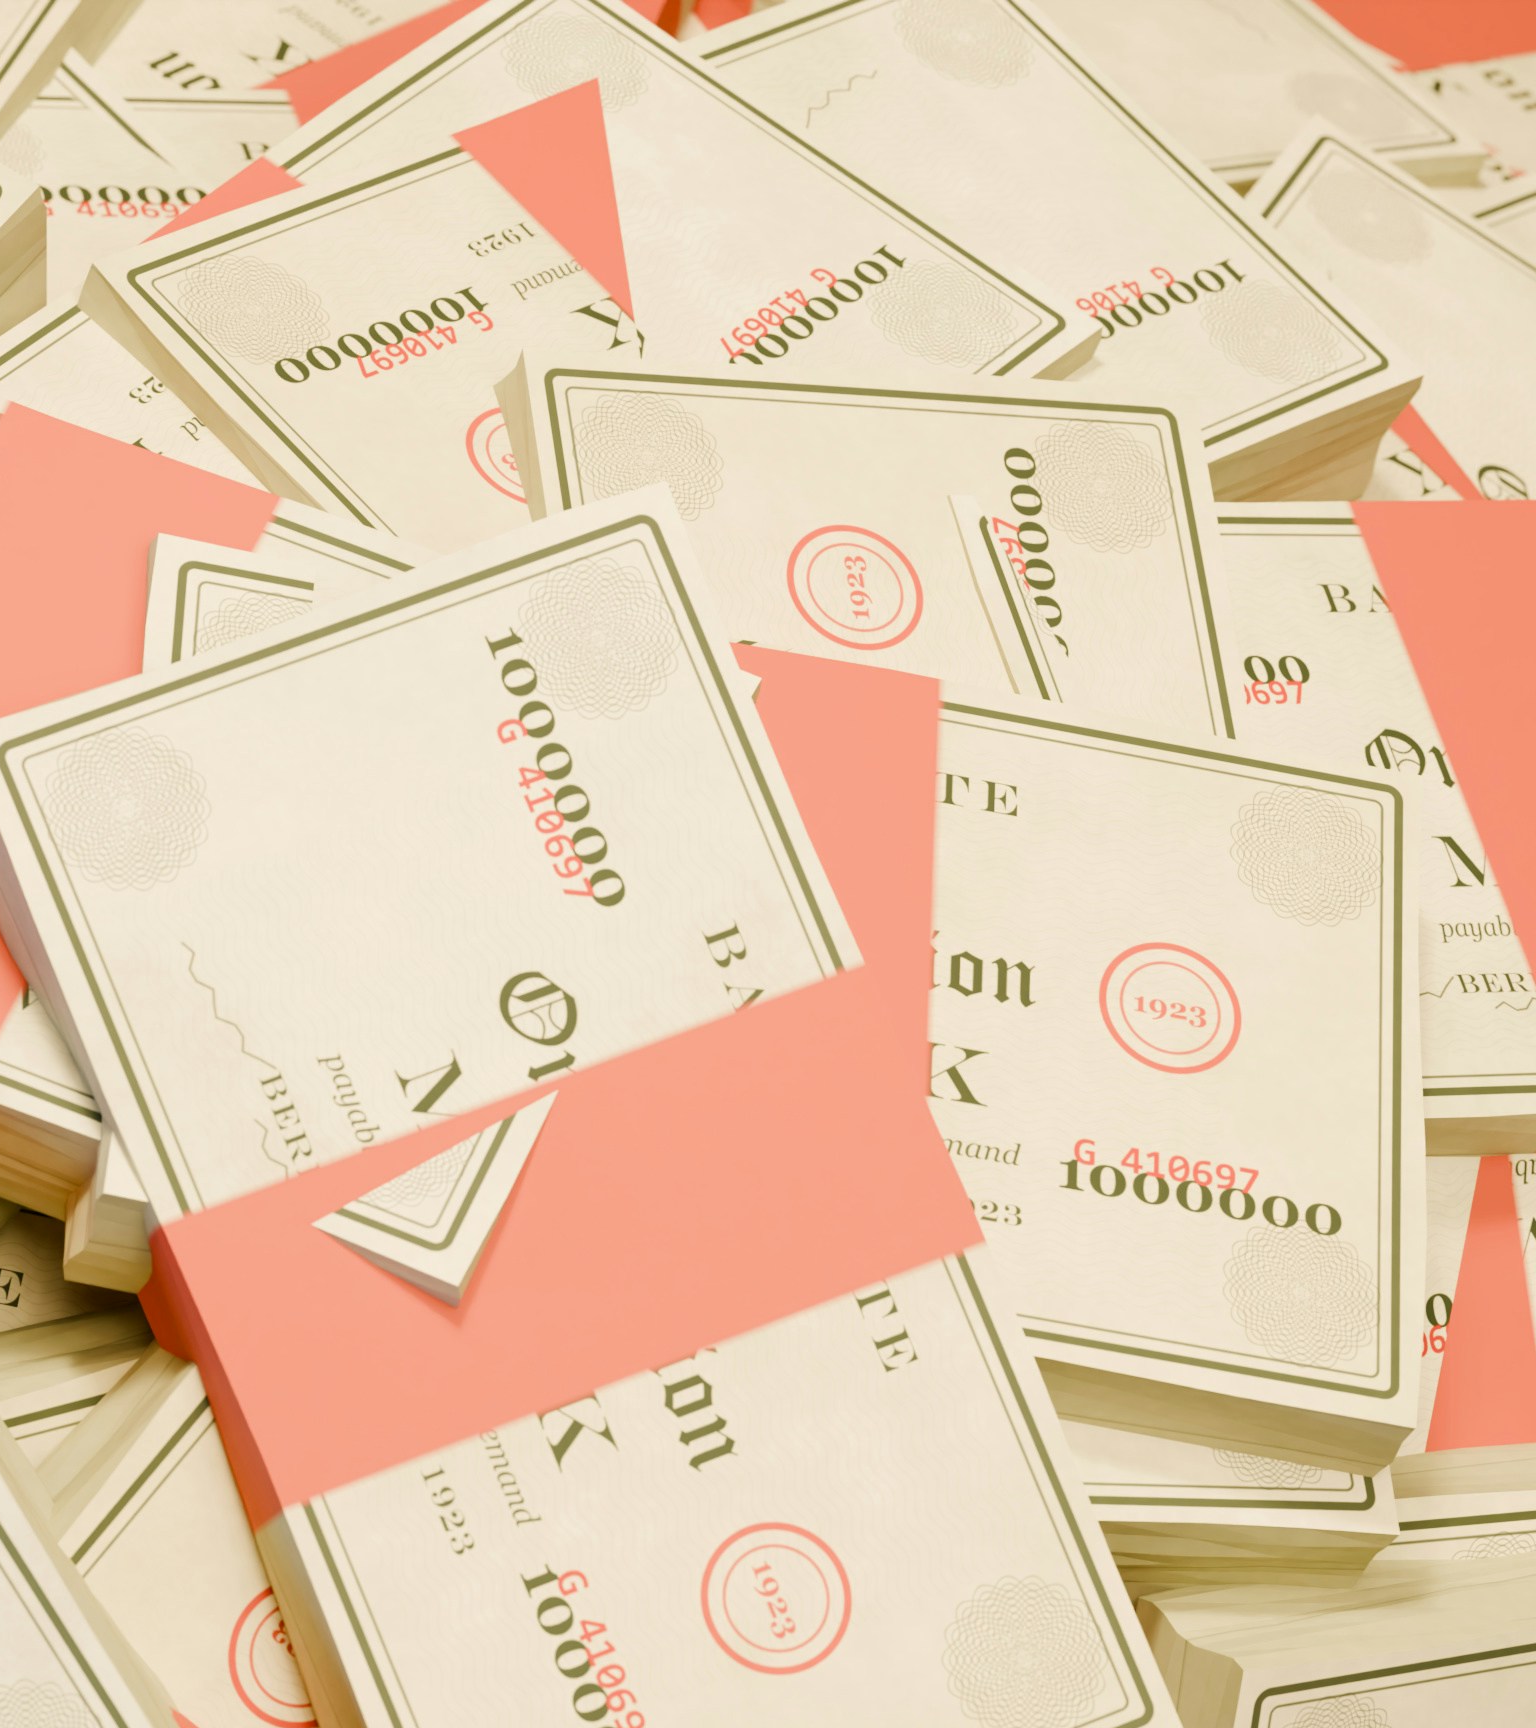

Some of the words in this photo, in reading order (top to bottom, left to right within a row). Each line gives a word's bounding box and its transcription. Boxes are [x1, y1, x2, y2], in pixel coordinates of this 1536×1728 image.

[466, 221, 536, 258] 1923
[808, 267, 839, 290] G
[1149, 266, 1176, 290] G
[273, 285, 490, 384] 1000000
[355, 324, 458, 379] 410697
[466, 309, 495, 334] G
[719, 287, 810, 360] 410697
[842, 554, 871, 618] 1923
[484, 626, 627, 908] 1000000
[496, 717, 530, 746] G
[518, 766, 596, 898] 410697
[1438, 913, 1512, 945] payab
[1135, 995, 1208, 1029] 1923
[316, 1053, 380, 1145] payab
[1072, 1137, 1096, 1167] G
[1120, 1146, 1260, 1196] 410697
[1058, 1158, 1343, 1237] 1000000
[422, 1467, 476, 1556] 1923
[556, 1568, 590, 1598] G
[752, 1562, 798, 1640] 1923
